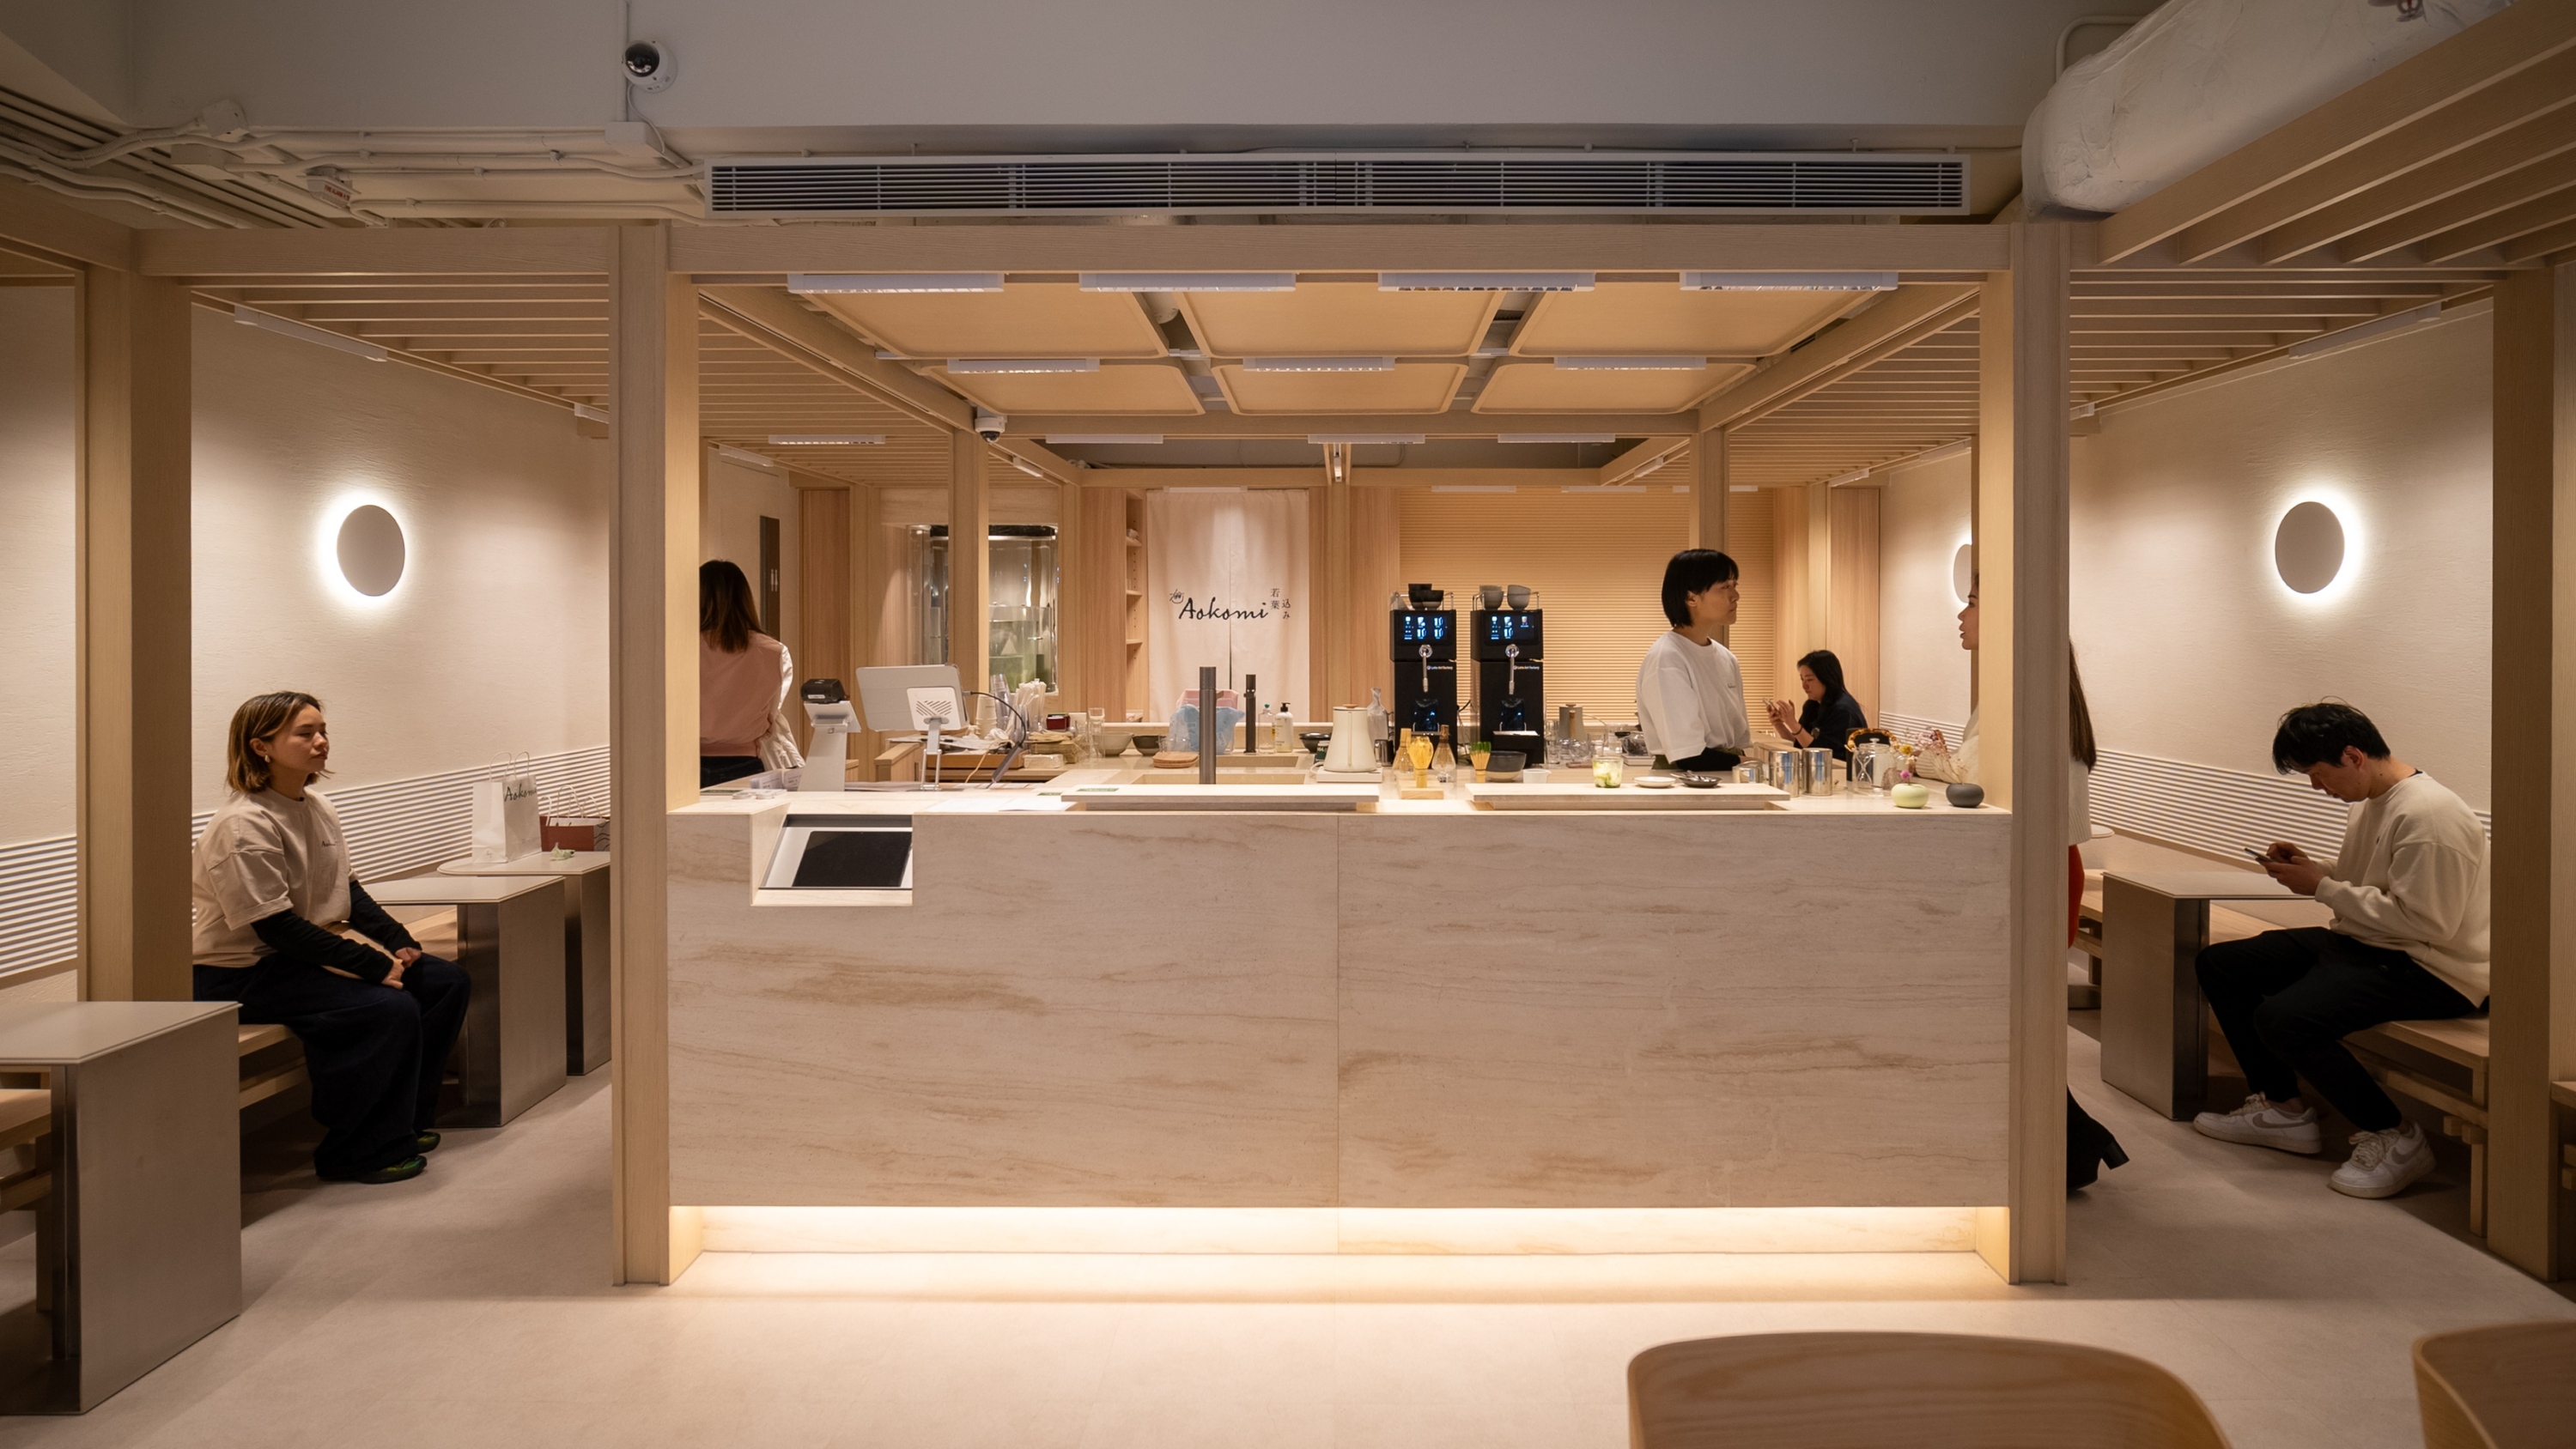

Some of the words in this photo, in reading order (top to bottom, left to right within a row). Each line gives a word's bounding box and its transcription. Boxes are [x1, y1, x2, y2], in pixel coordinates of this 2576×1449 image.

[1178, 597, 1269, 621] Aokomi
[1270, 587, 1280, 610] 若葉
[1281, 598, 1291, 620] 込み
